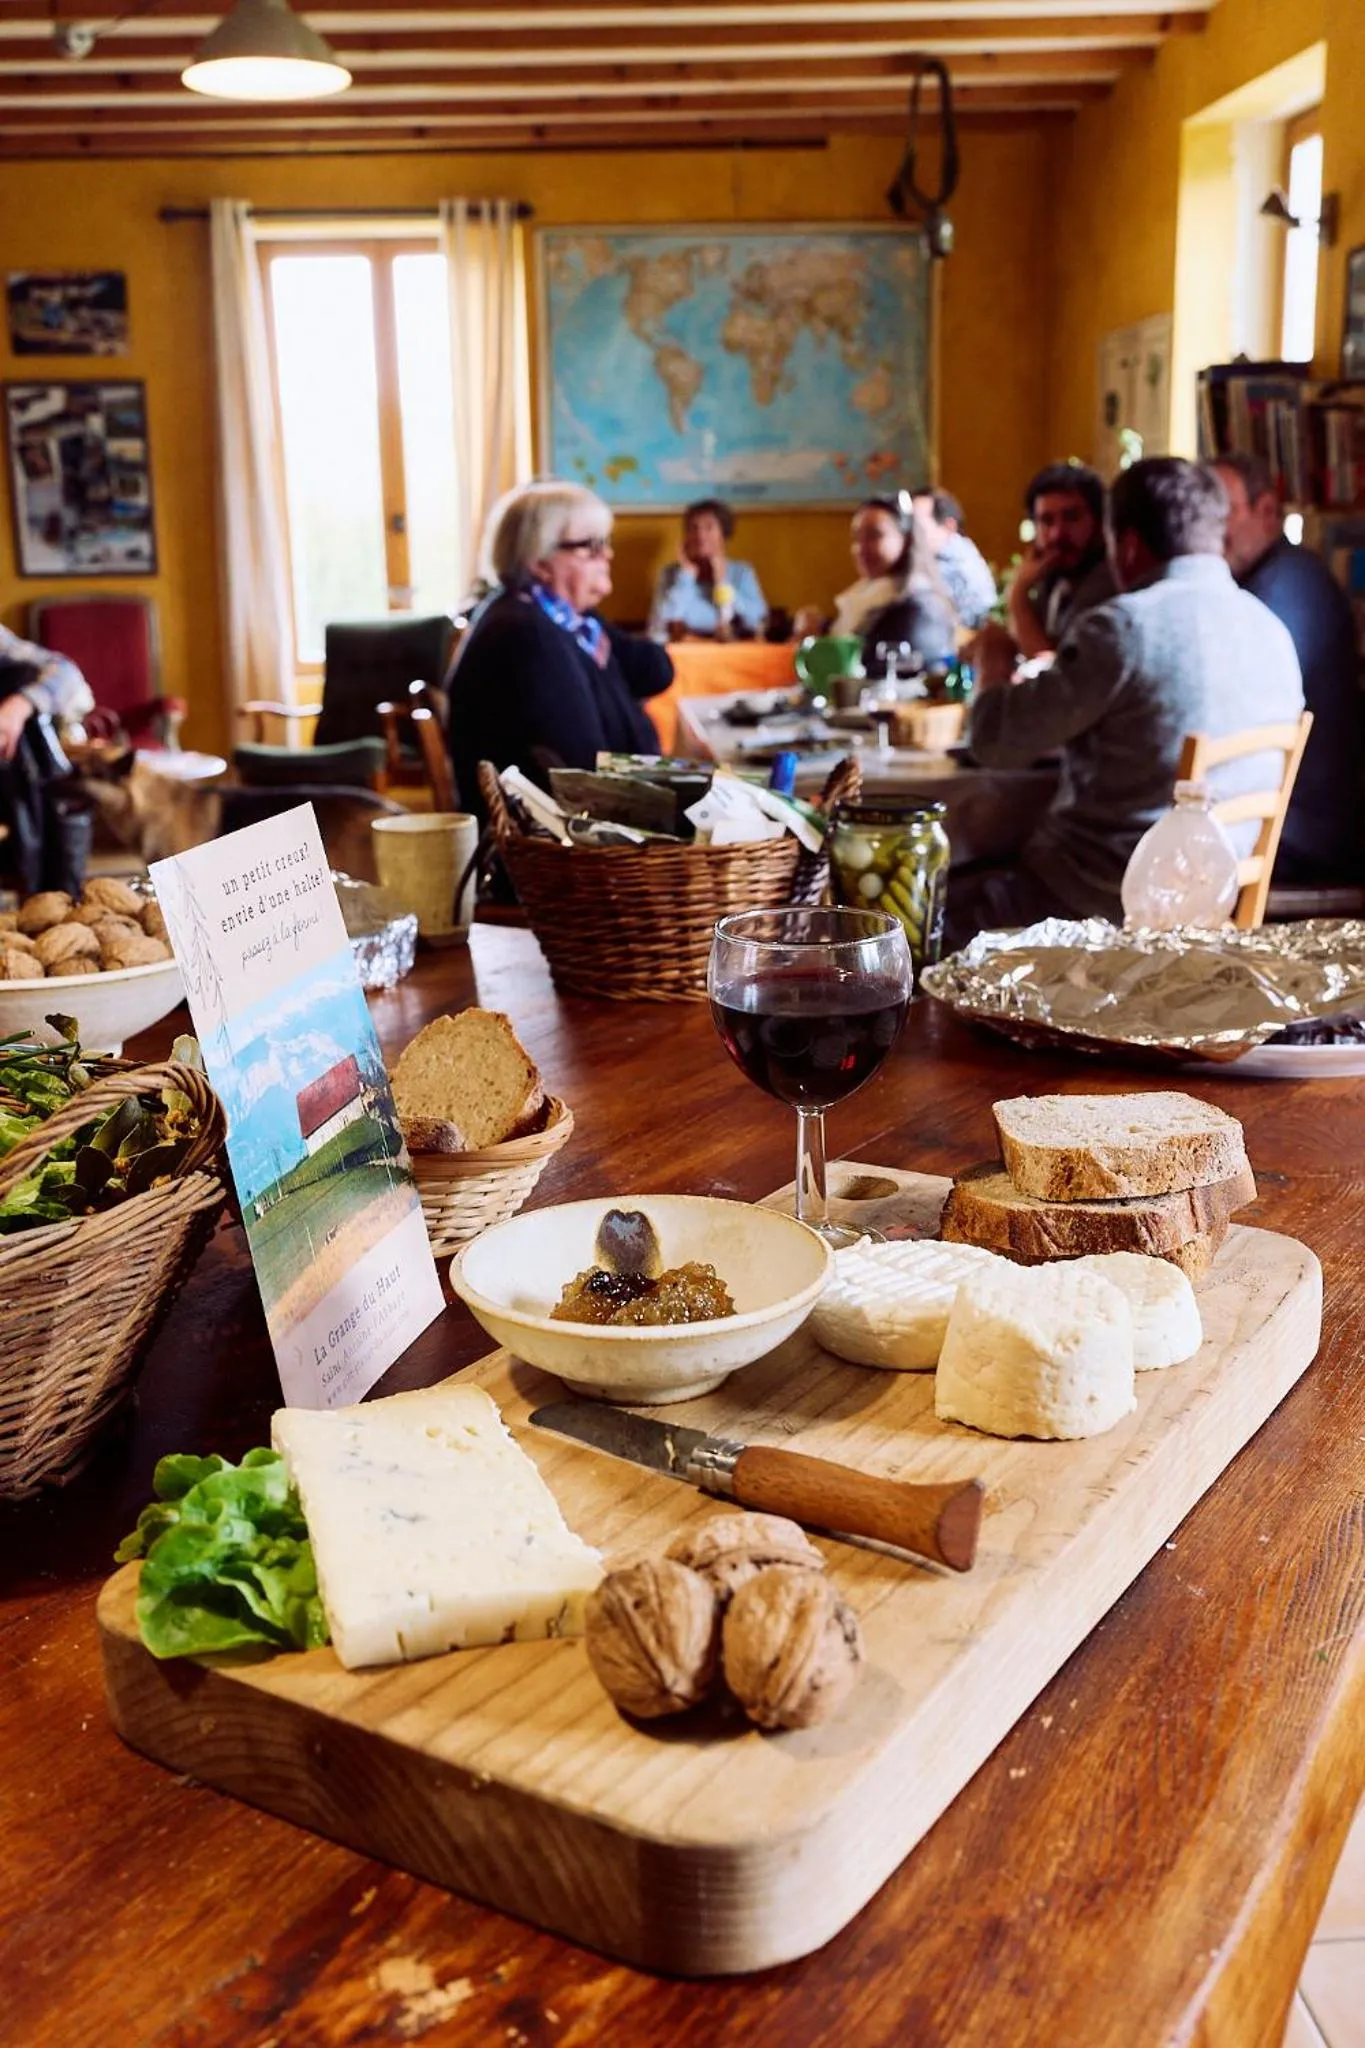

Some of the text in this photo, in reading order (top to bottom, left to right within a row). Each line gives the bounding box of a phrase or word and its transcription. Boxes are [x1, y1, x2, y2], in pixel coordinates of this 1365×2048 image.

[221, 868, 325, 933] envie d'une halte?
[222, 842, 310, 896] un petit creux?
[313, 1265, 401, 1366] La Grange du Haut
